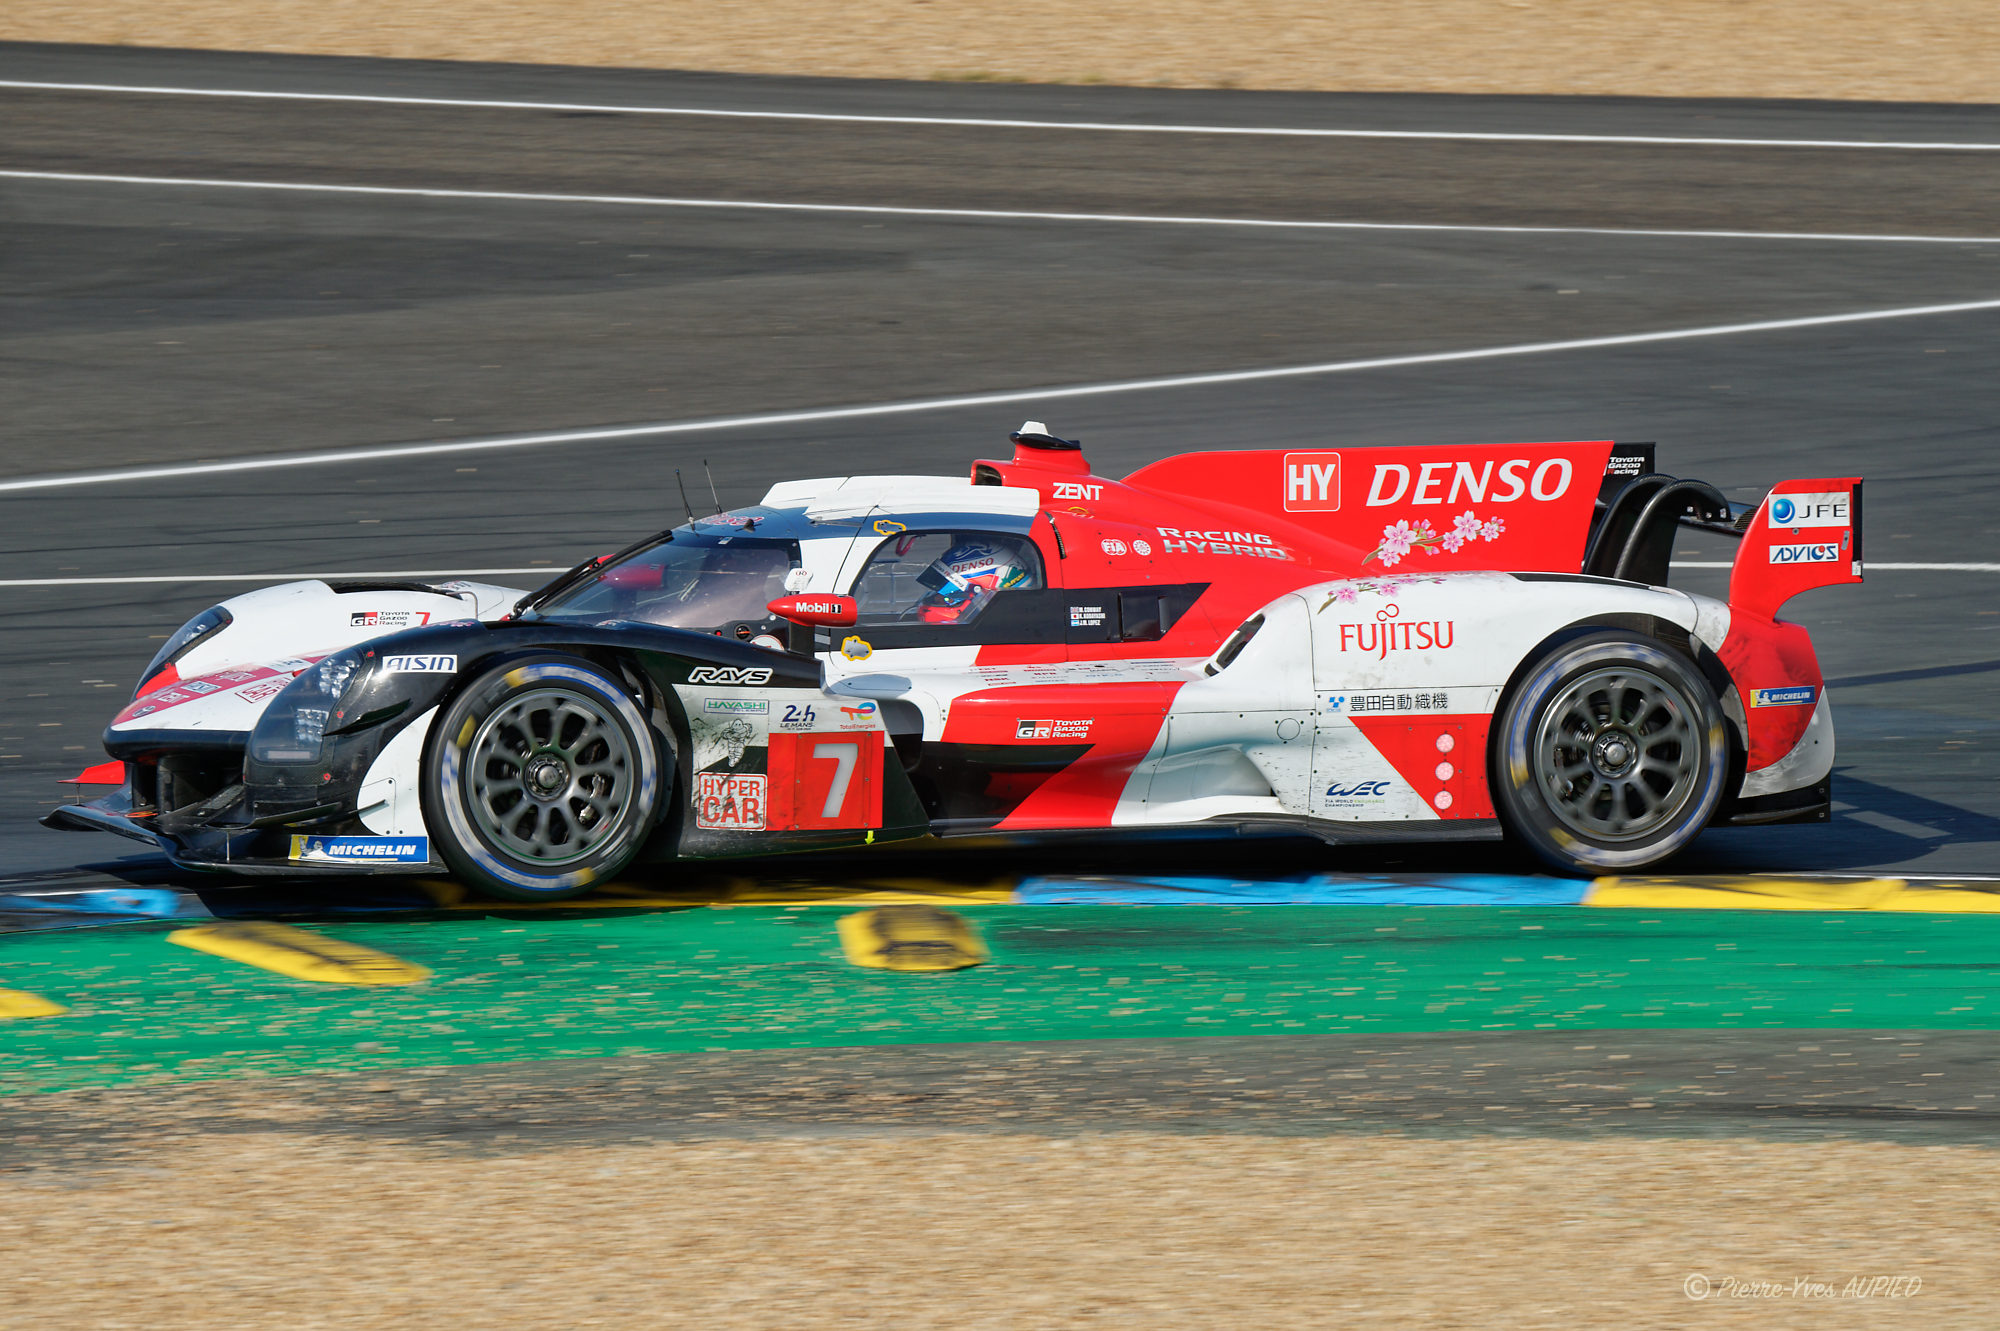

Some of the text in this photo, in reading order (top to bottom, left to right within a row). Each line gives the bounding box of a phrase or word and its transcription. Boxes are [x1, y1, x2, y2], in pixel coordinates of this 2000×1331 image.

[1607, 468, 1639, 476] Racing
[1053, 482, 1103, 500] ZENT
[1288, 464, 1336, 501] HY
[1366, 458, 1573, 507] DENSO
[1799, 503, 1847, 518] JFE
[1156, 527, 1273, 545] RACING
[1163, 539, 1287, 560] HYBRID
[1772, 545, 1837, 562] ADVICS
[951, 557, 995, 574] DENSO
[796, 602, 829, 613] Mobil
[415, 611, 431, 626] 7
[1339, 620, 1454, 661] FUJITSU
[387, 656, 454, 671] AISIN
[689, 667, 772, 684] RAYS
[707, 700, 766, 709] HAYASHI
[1350, 692, 1449, 712] 豊田自動織機
[1771, 691, 1811, 701] MICHELIN
[782, 704, 816, 722] 24h
[1052, 731, 1088, 739] Racing
[703, 779, 760, 797] HYPER
[813, 743, 859, 818] 7
[1326, 781, 1391, 796] WEC
[703, 796, 760, 824] CAR
[328, 845, 416, 855] MICHELIN
